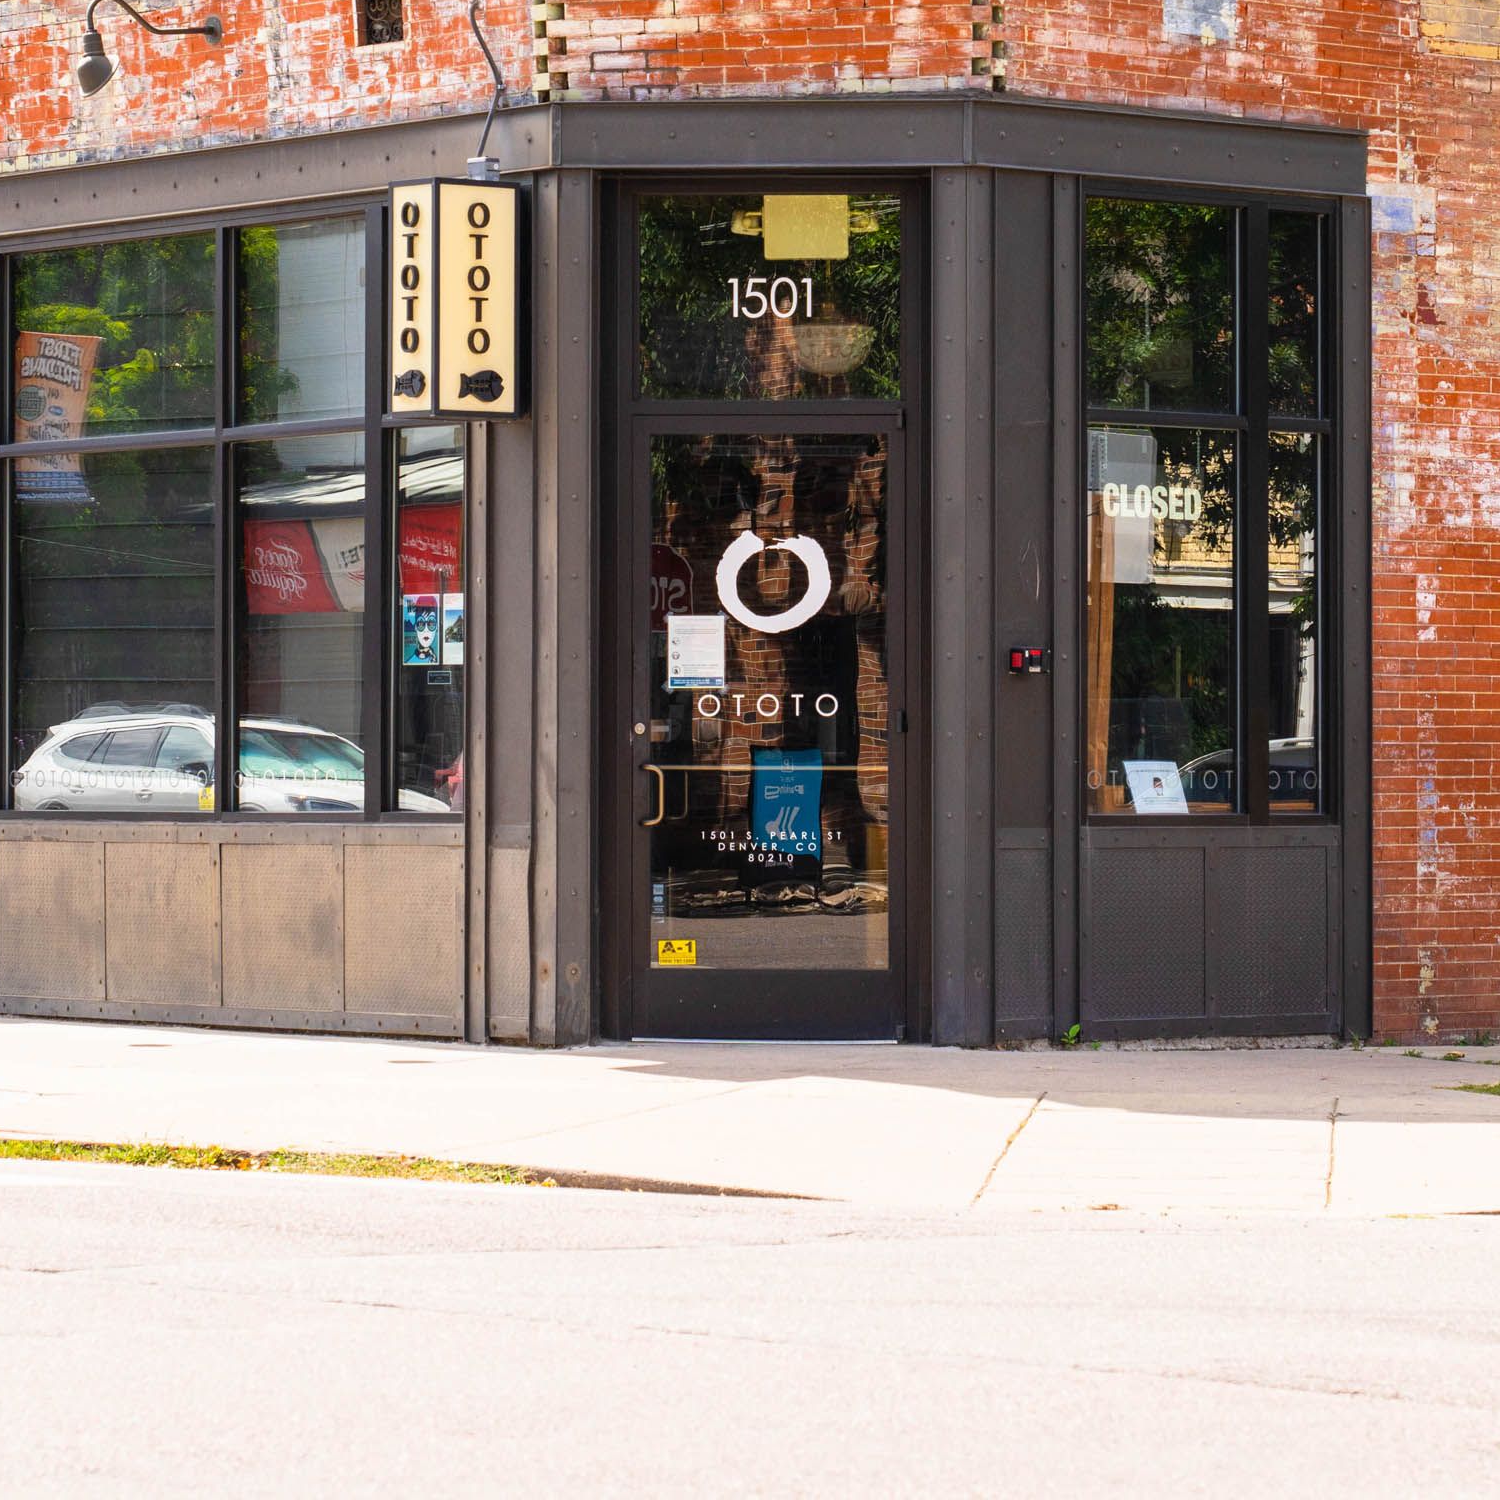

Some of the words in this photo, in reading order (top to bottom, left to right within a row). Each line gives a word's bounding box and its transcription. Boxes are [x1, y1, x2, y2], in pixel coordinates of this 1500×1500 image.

[401, 201, 420, 353] OTOTO
[467, 202, 490, 354] OTOTO
[727, 277, 812, 319] 1501
[1103, 482, 1202, 521] CLOSED
[697, 693, 838, 717] OTOTO
[701, 831, 735, 840] 1501
[746, 831, 759, 840] S.
[770, 831, 817, 840] PEARL
[828, 831, 842, 840] ST
[796, 842, 817, 851] CO
[748, 854, 794, 862] 80210
[662, 941, 693, 953] A-1
